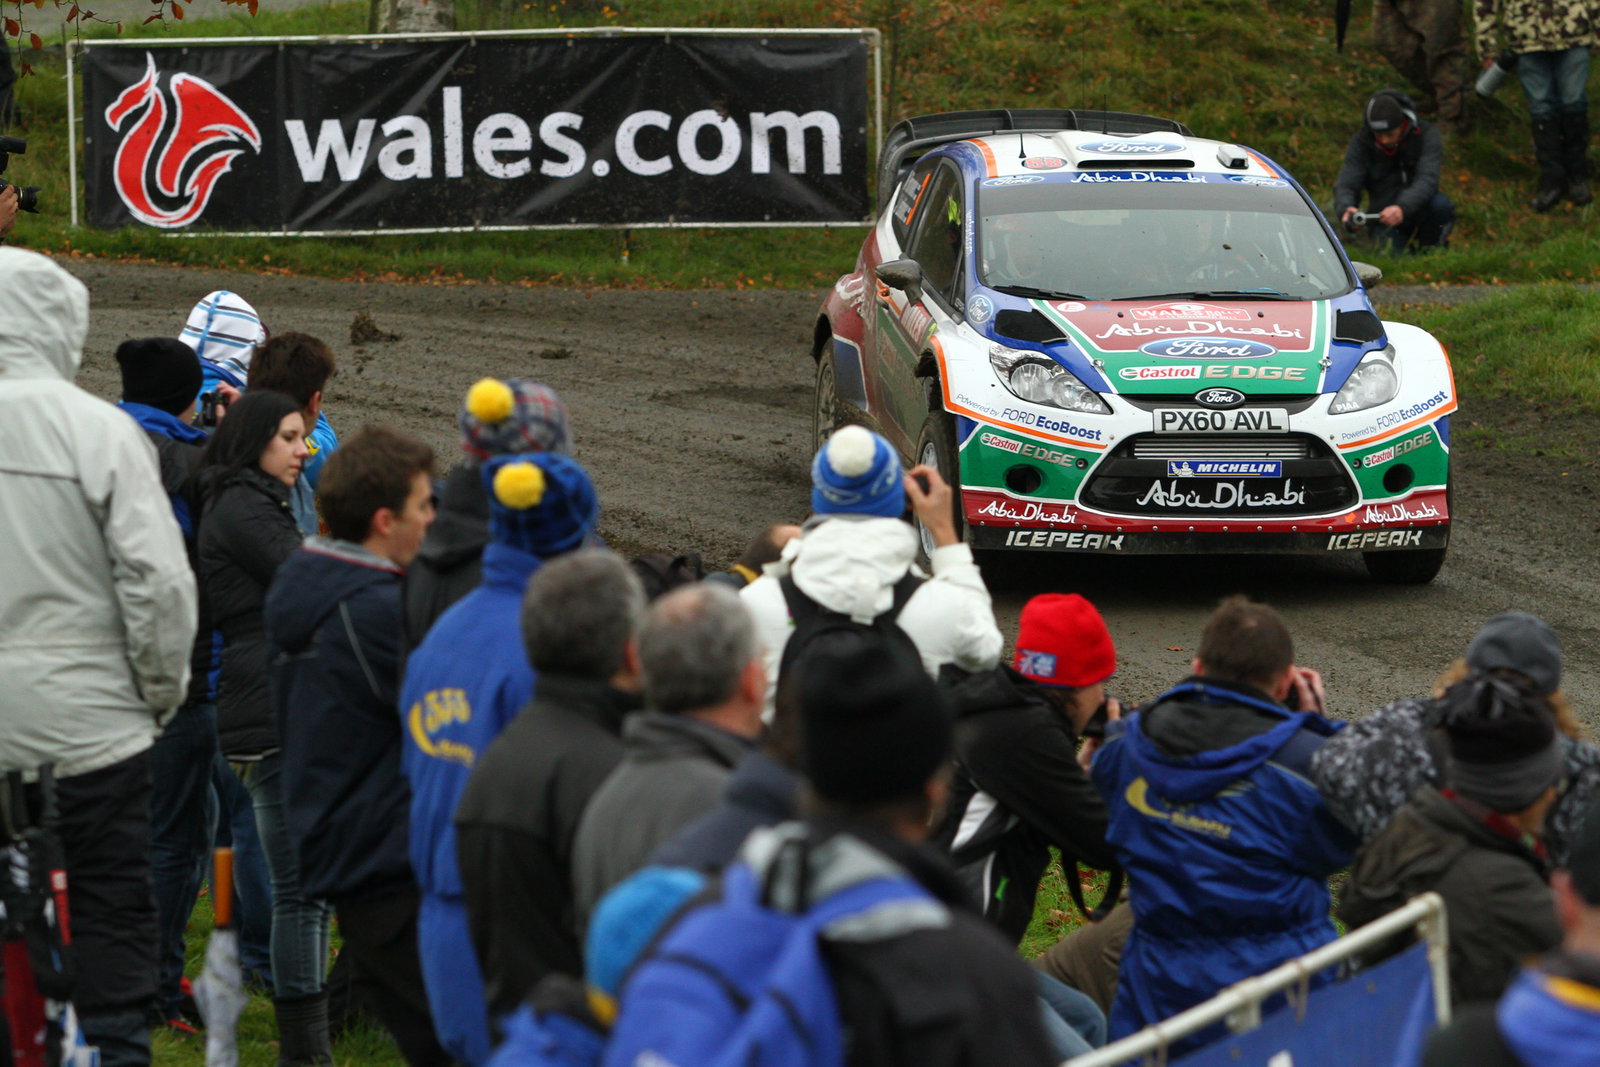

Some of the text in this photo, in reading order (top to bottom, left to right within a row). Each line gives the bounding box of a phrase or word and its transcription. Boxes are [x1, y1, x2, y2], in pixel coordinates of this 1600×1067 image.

[285, 86, 842, 182] wales.com
[1097, 141, 1167, 153] Ford
[1166, 339, 1251, 356] Ford
[1139, 365, 1308, 381] Castrol EDGE
[1074, 402, 1101, 411] PIAA
[1206, 391, 1234, 403] Ford
[1336, 402, 1359, 411] PIAA
[956, 393, 1102, 441] Powered by FORD EcoBoost
[1160, 411, 1282, 431] PX60 AVL
[1342, 426, 1369, 440] Powered
[1377, 412, 1400, 430] FORD
[1400, 390, 1448, 420] EcoBoost
[989, 436, 1076, 467] Castrol EDGE
[1371, 431, 1432, 464] Castrol EDGE
[1197, 463, 1277, 473] MICHELIN
[1005, 530, 1125, 550] ICEPEAK
[1327, 530, 1423, 551] ICEPEAK
